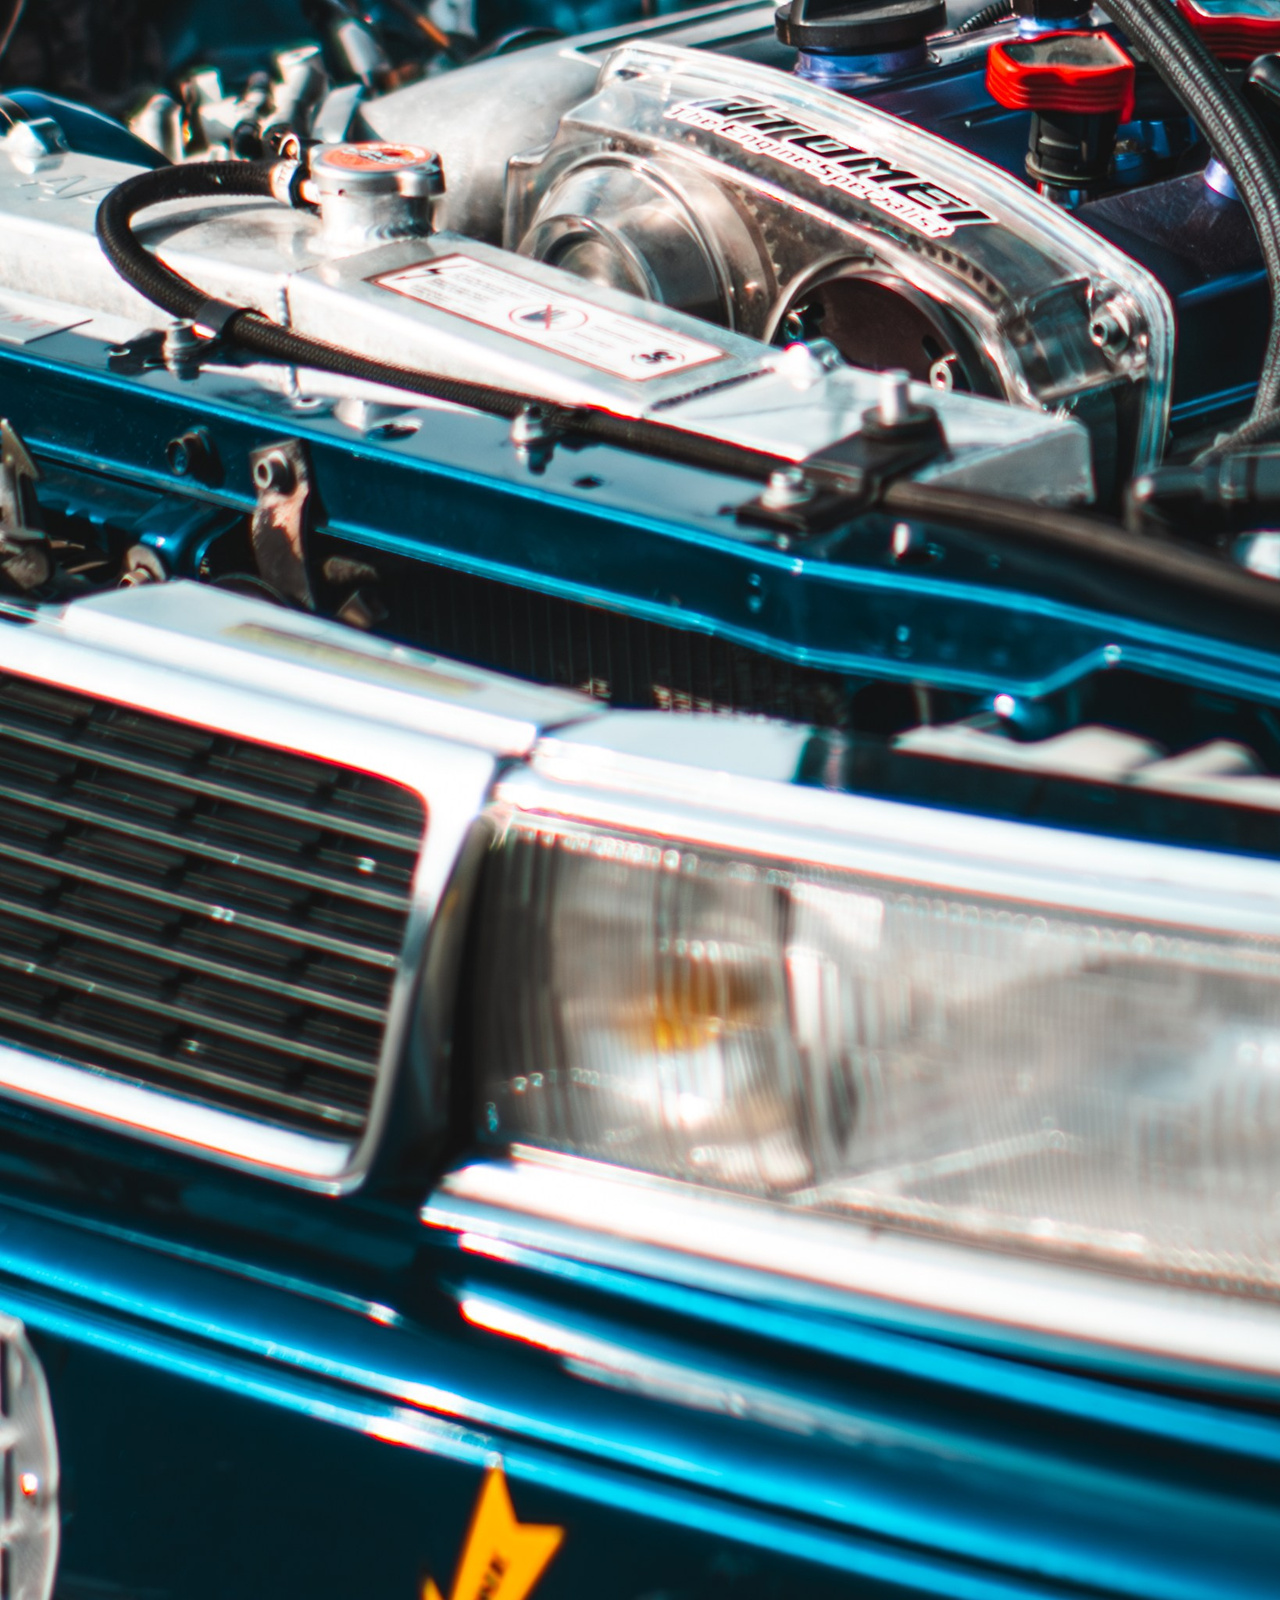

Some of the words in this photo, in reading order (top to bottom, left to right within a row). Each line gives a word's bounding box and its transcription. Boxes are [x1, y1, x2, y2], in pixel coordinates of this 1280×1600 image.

[669, 106, 719, 127] The
[719, 123, 811, 166] Engine
[811, 163, 949, 234] Specialist
